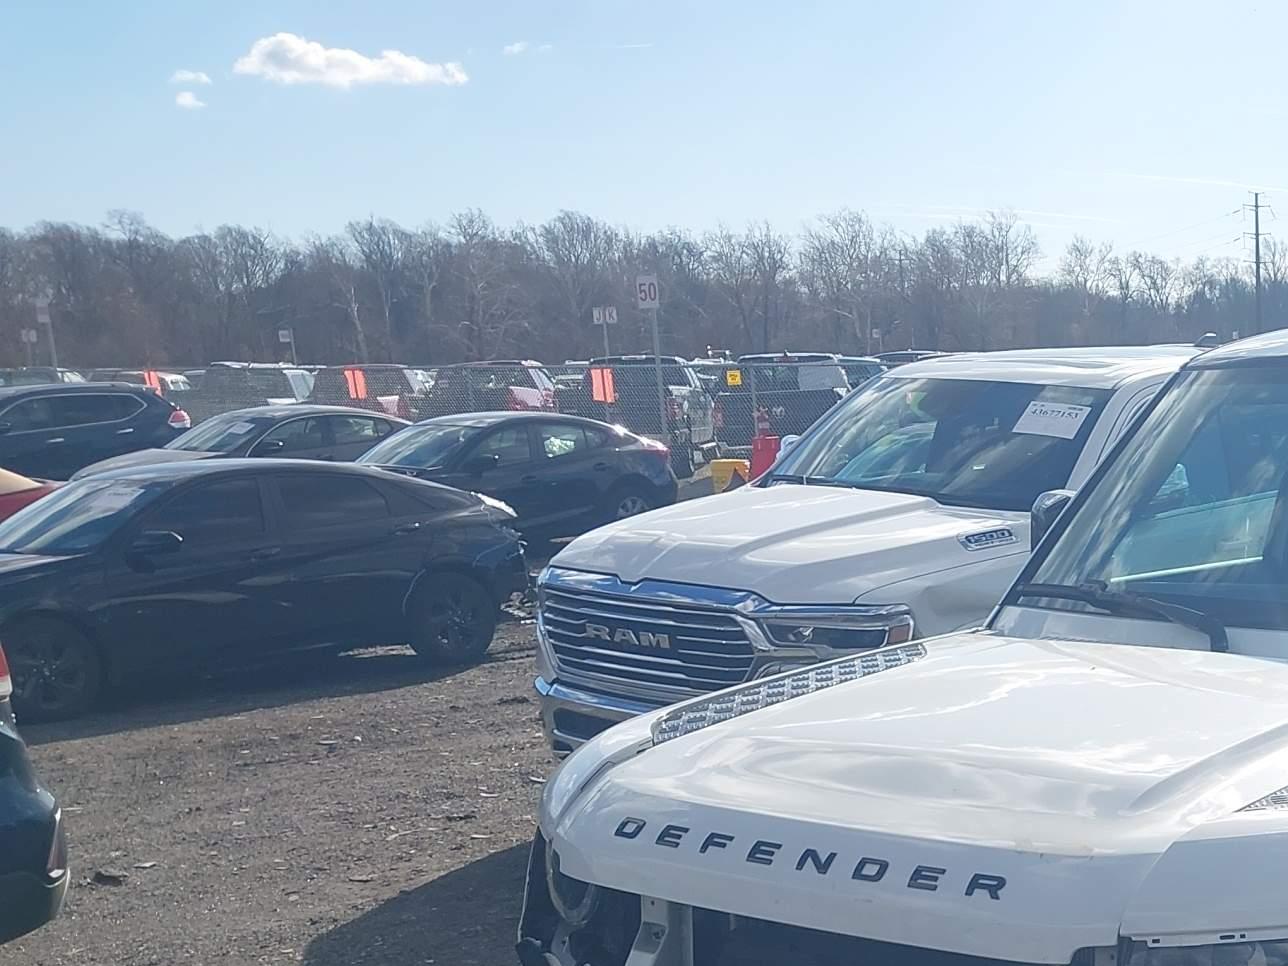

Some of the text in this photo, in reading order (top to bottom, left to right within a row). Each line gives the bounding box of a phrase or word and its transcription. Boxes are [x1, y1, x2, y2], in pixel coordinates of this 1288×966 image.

[638, 282, 657, 301] 50
[967, 530, 1010, 543] 1500
[585, 623, 671, 648] RAM
[613, 816, 1008, 900] DEFENDER
